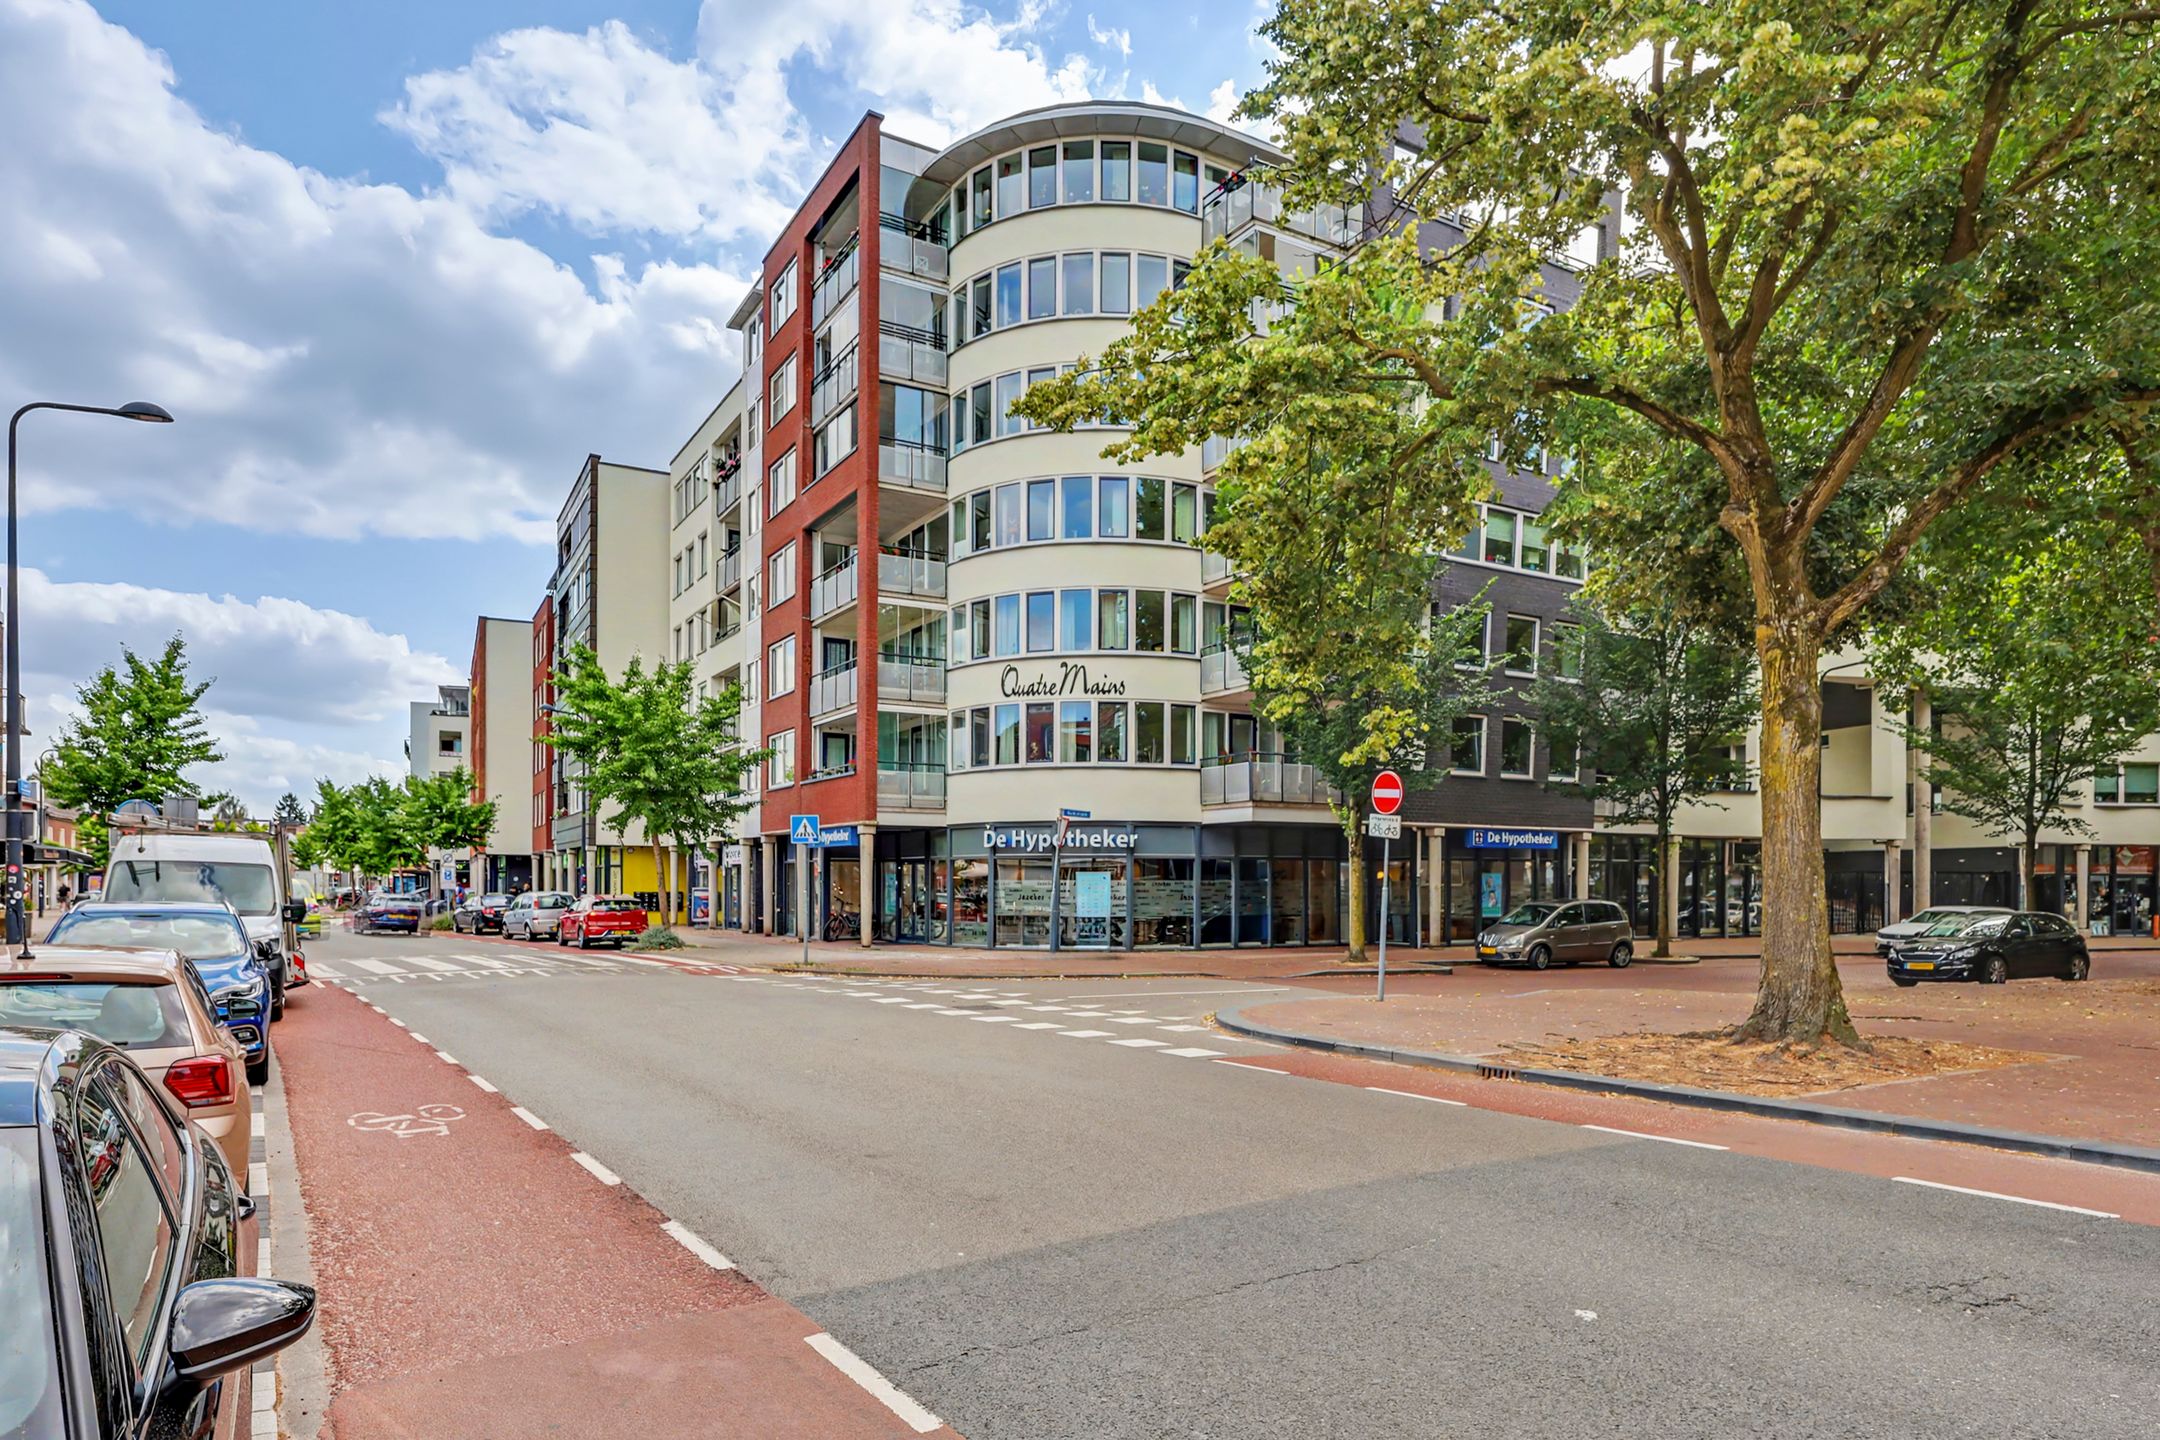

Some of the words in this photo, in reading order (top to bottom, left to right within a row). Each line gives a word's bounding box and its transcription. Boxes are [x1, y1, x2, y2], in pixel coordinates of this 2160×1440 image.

[1001, 664, 1058, 698] Quatre
[1059, 661, 1126, 696] Mains
[983, 830, 1006, 848] De
[1011, 829, 1138, 852] Hypotheker
[1487, 831, 1501, 843] De
[1502, 832, 1554, 847] Hypotheker
